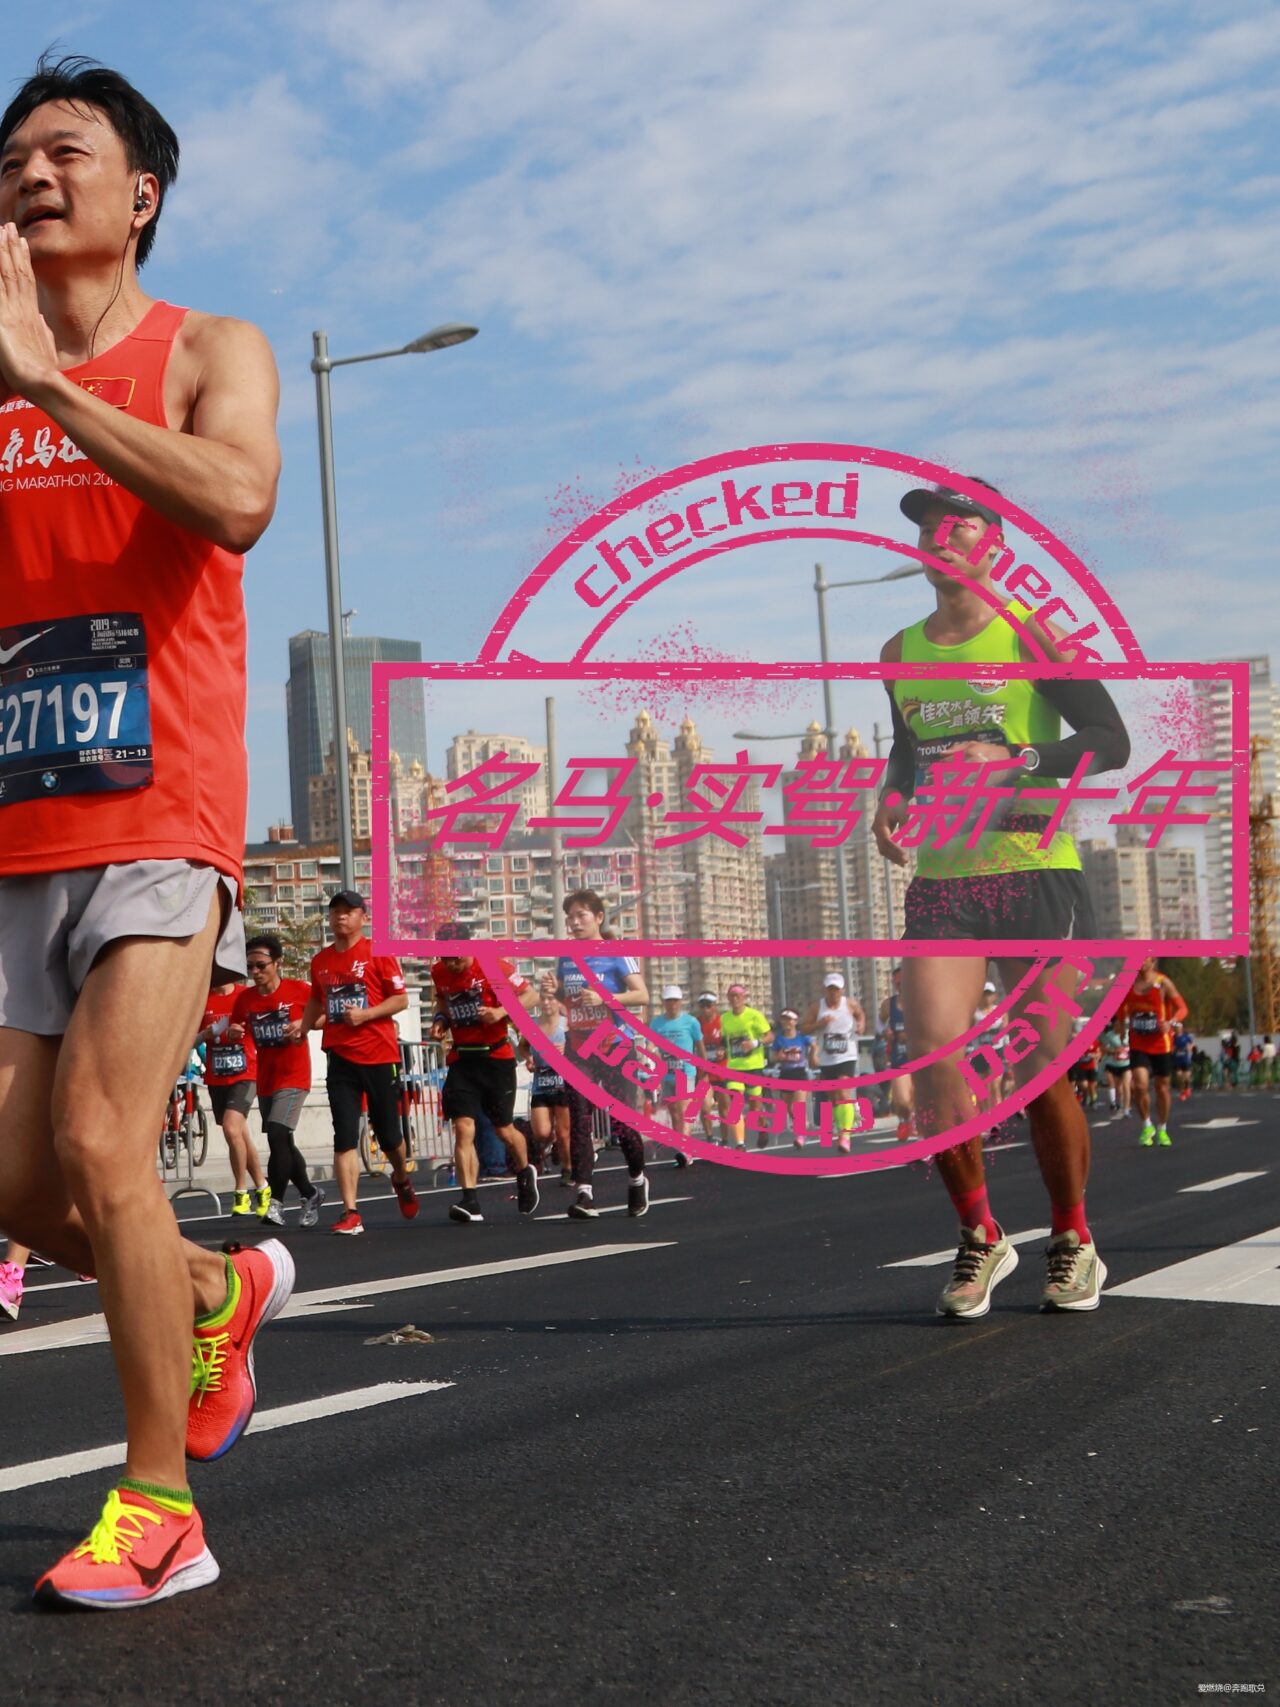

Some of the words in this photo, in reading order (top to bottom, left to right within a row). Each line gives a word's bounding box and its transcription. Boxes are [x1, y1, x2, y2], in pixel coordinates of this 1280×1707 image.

[16, 473, 91, 491] MARATHON
[90, 619, 110, 631] 2019
[570, 1005, 608, 1023] B51369
[214, 1055, 243, 1069] E27523
